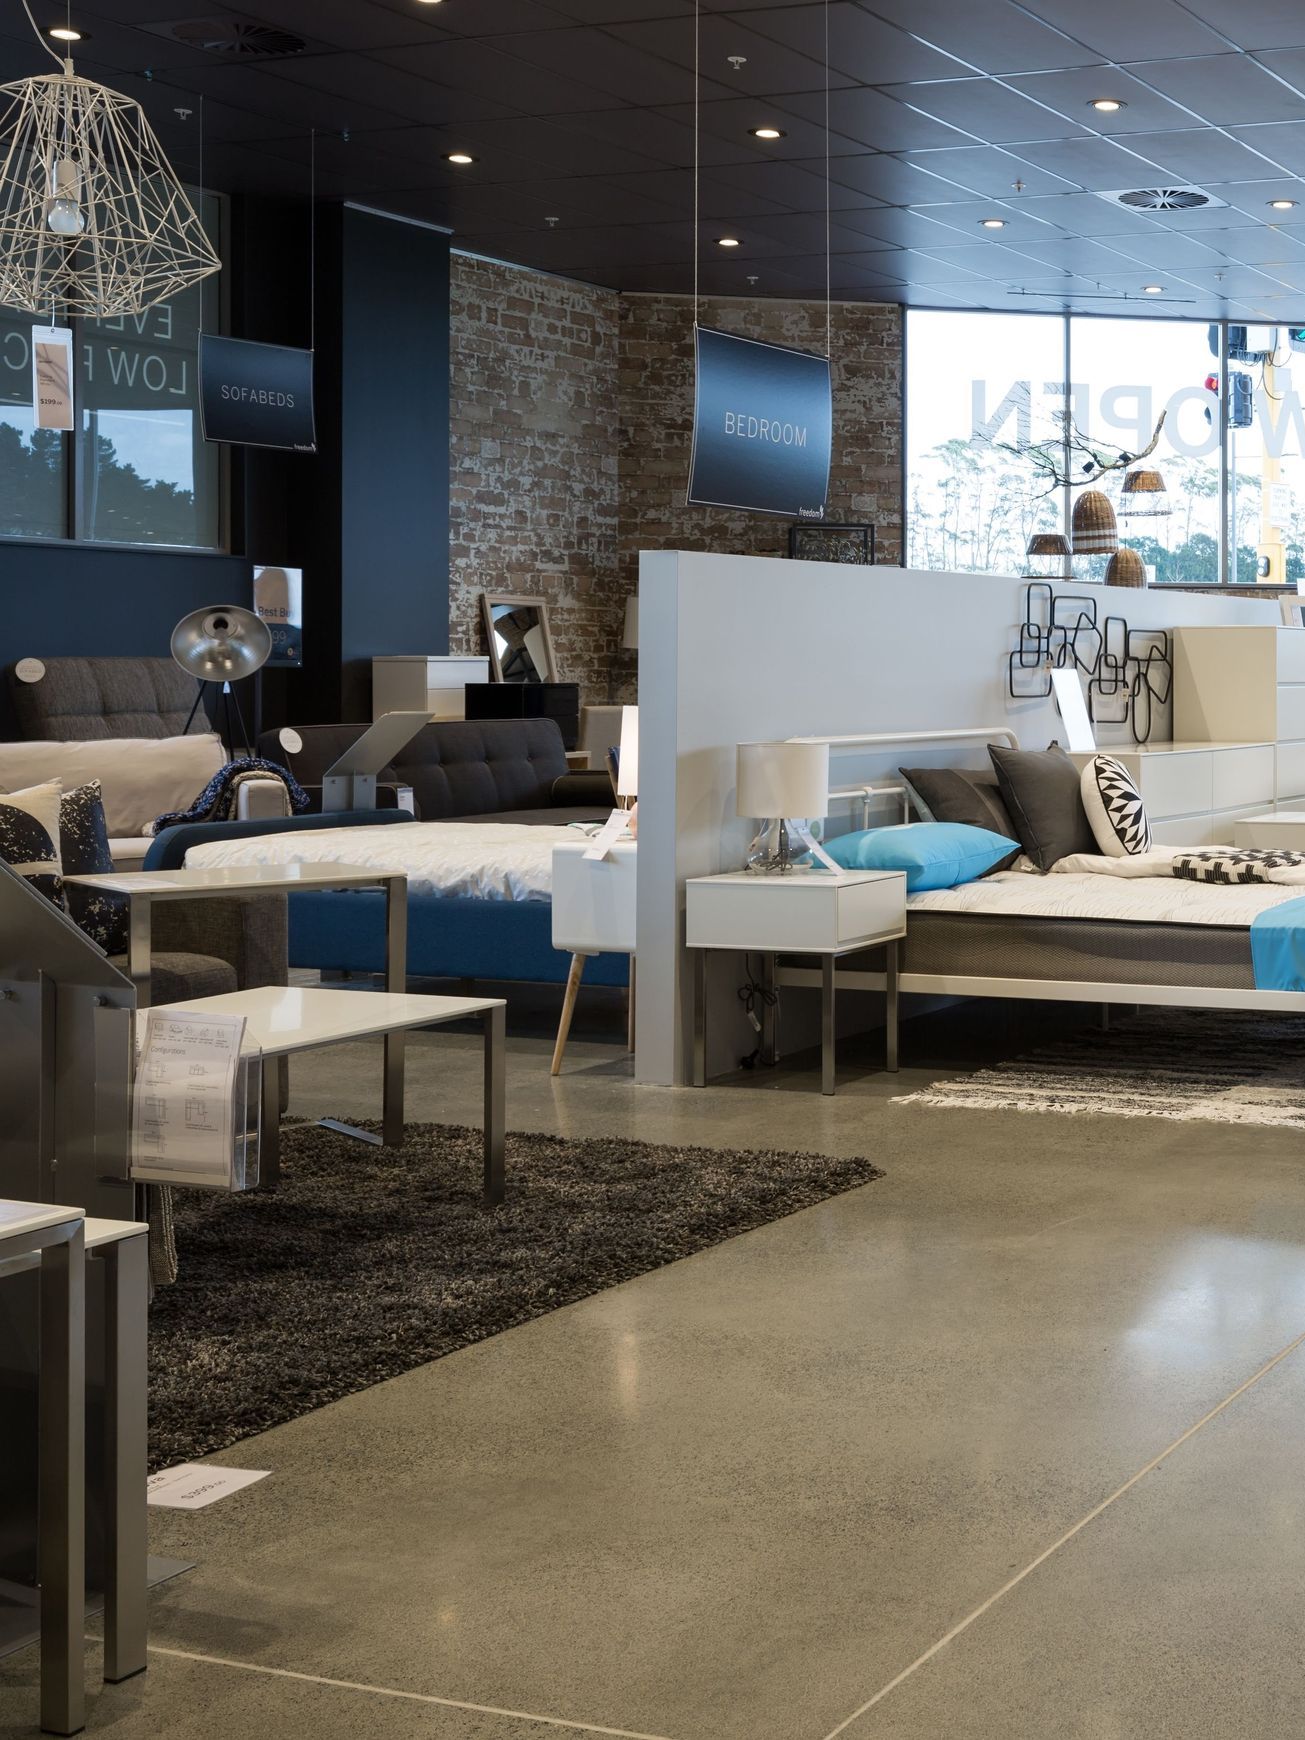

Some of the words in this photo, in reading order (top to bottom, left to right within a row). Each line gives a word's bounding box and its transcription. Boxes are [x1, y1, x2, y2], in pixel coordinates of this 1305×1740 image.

[221, 384, 295, 408] SOFABEDS
[724, 411, 807, 448] BEDROOM
[798, 506, 820, 518] freedom
[258, 606, 277, 617] Best
[150, 1045, 186, 1056] Configurations
